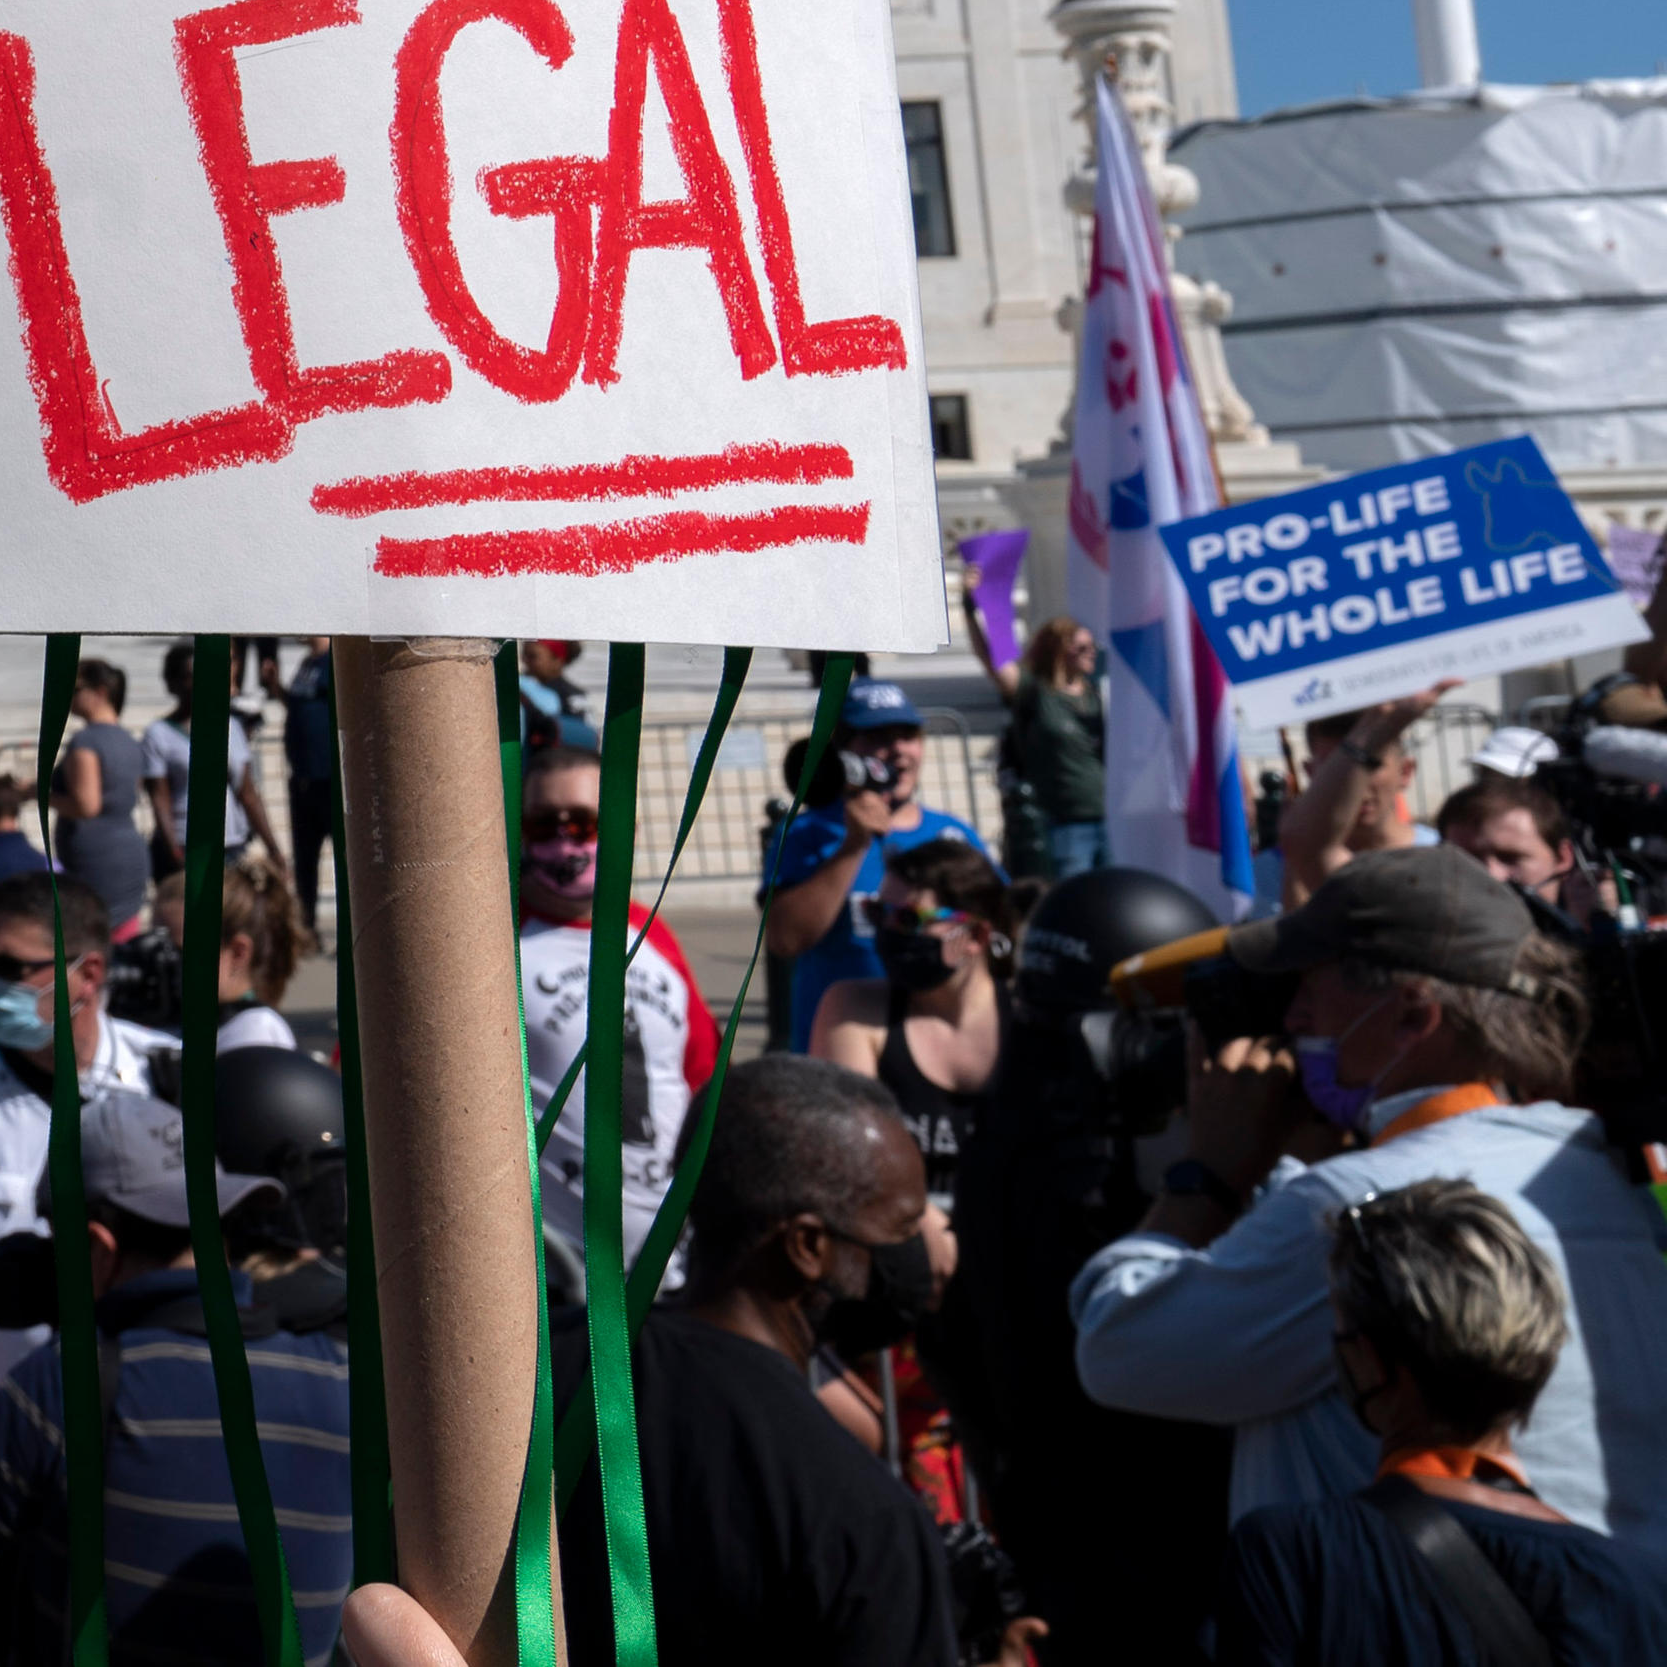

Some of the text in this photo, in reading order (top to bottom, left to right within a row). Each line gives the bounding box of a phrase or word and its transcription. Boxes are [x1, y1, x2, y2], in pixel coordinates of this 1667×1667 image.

[1187, 475, 1452, 573] PRO-LIFE
[1208, 521, 1463, 618] FOR THE
[1226, 575, 1447, 662] WHOLE
[1458, 542, 1588, 606] LIFE
